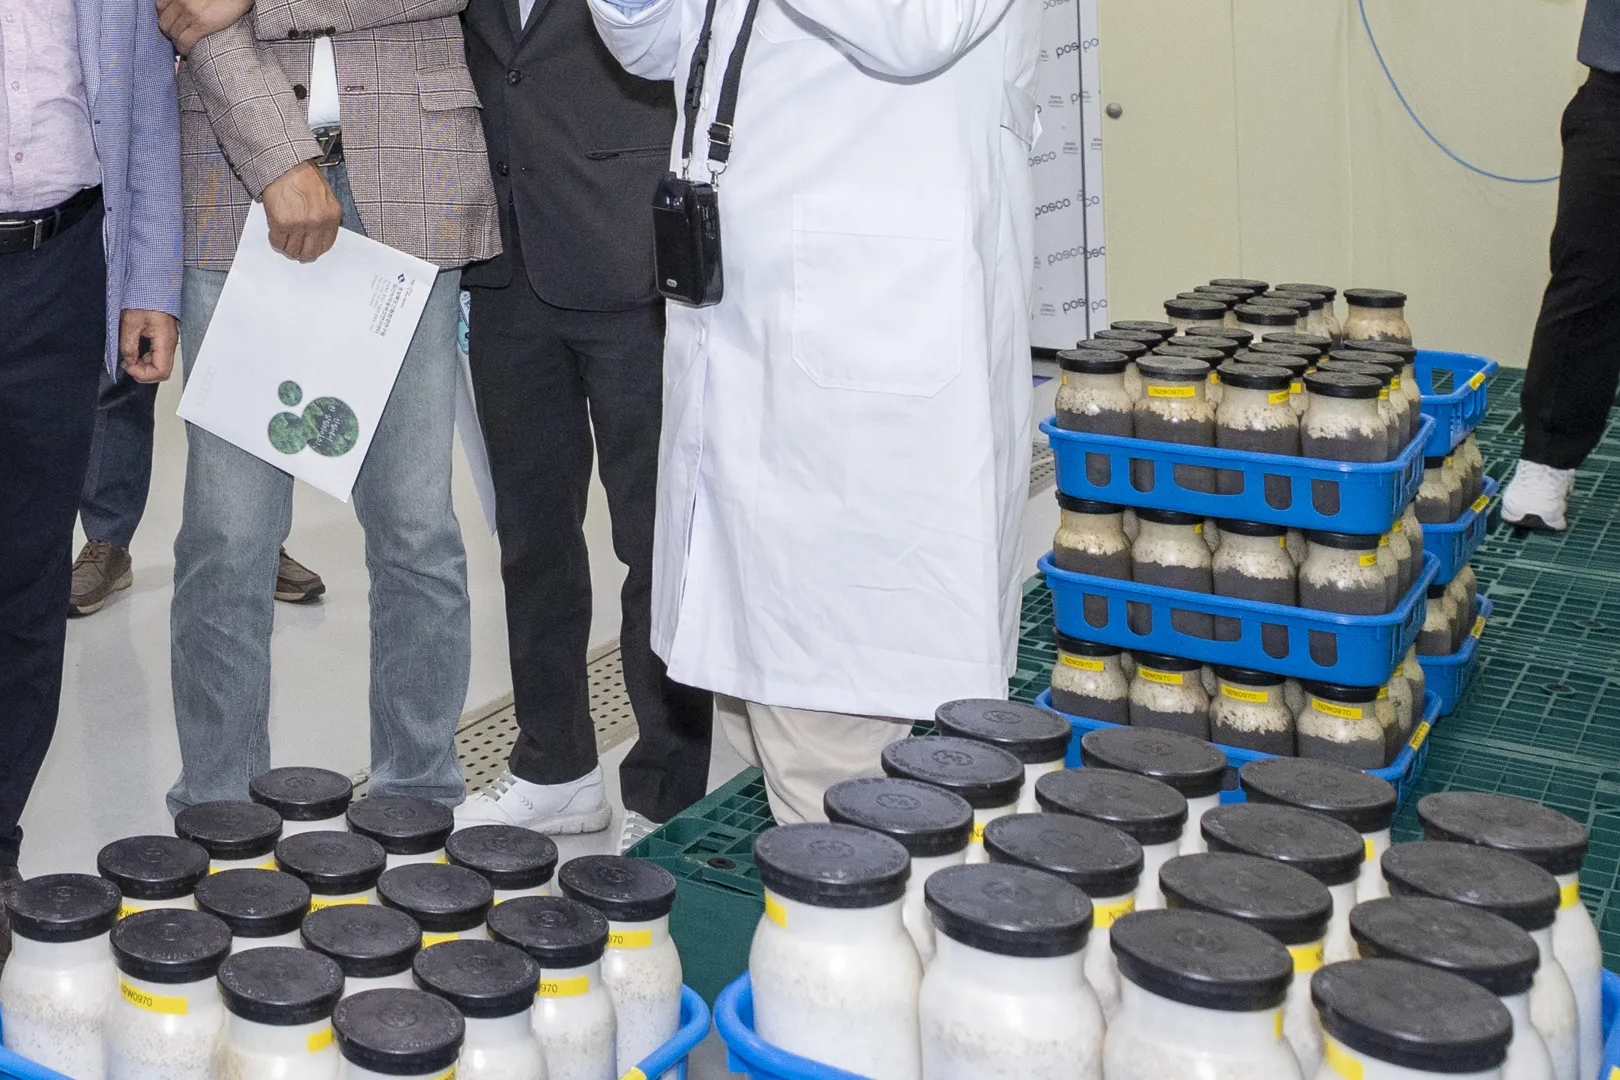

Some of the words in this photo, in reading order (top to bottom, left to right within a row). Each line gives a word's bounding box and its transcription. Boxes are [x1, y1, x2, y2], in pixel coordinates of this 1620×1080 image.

[1035, 198, 1071, 219] posco
[1048, 245, 1085, 265] posco
[1064, 656, 1094, 669] N2W0970
[1141, 669, 1172, 682] N2W0970
[1225, 687, 1257, 700] N2W0970
[1318, 702, 1352, 716] N2W0970
[120, 981, 153, 1007] N2W0970
